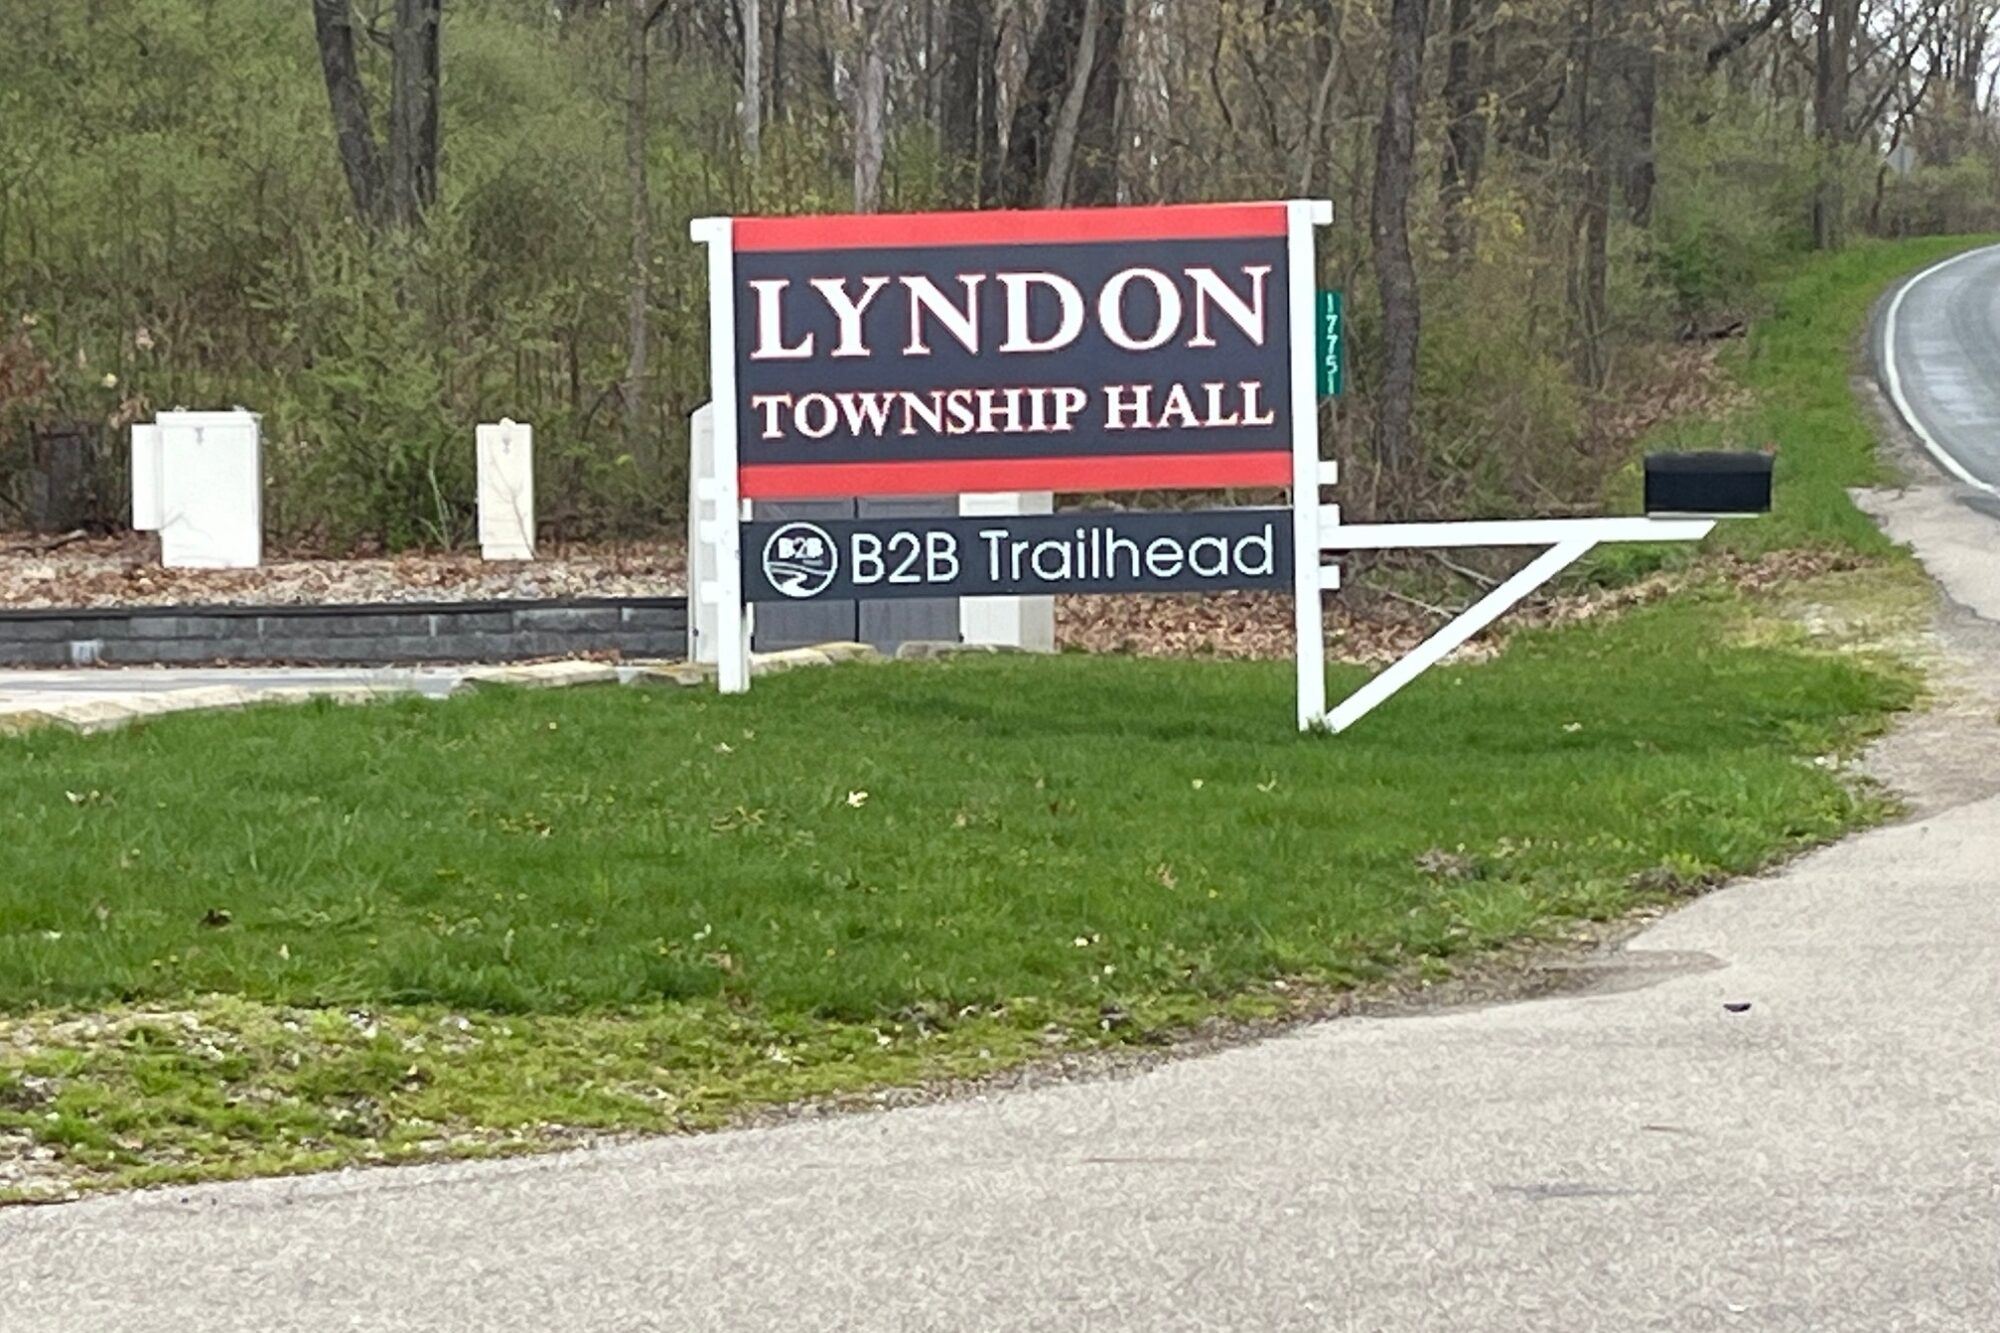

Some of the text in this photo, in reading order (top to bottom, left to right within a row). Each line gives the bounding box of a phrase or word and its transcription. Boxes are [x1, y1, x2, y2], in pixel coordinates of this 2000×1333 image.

[749, 265, 1272, 360] LYNDON
[1326, 293, 1338, 394] 17751
[751, 381, 1275, 439] TOWNSHIP HALL
[778, 537, 823, 559] B2B
[851, 524, 1274, 585] B2B Trailhead
